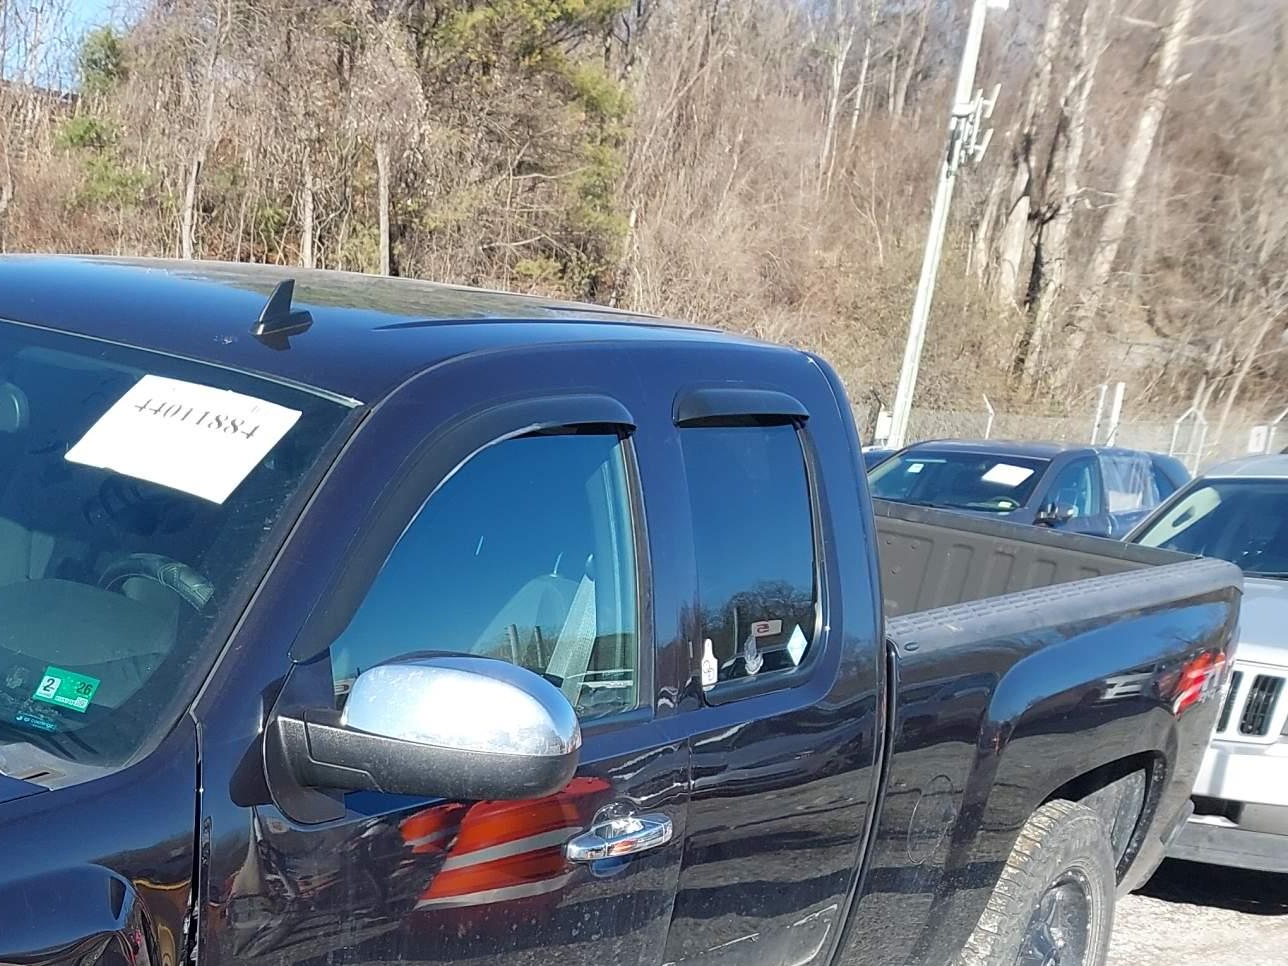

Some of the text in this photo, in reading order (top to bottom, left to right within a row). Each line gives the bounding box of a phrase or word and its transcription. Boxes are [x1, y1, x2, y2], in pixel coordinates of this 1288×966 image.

[133, 397, 261, 440] 44011884
[42, 678, 55, 692] 2
[76, 681, 93, 696] 26
